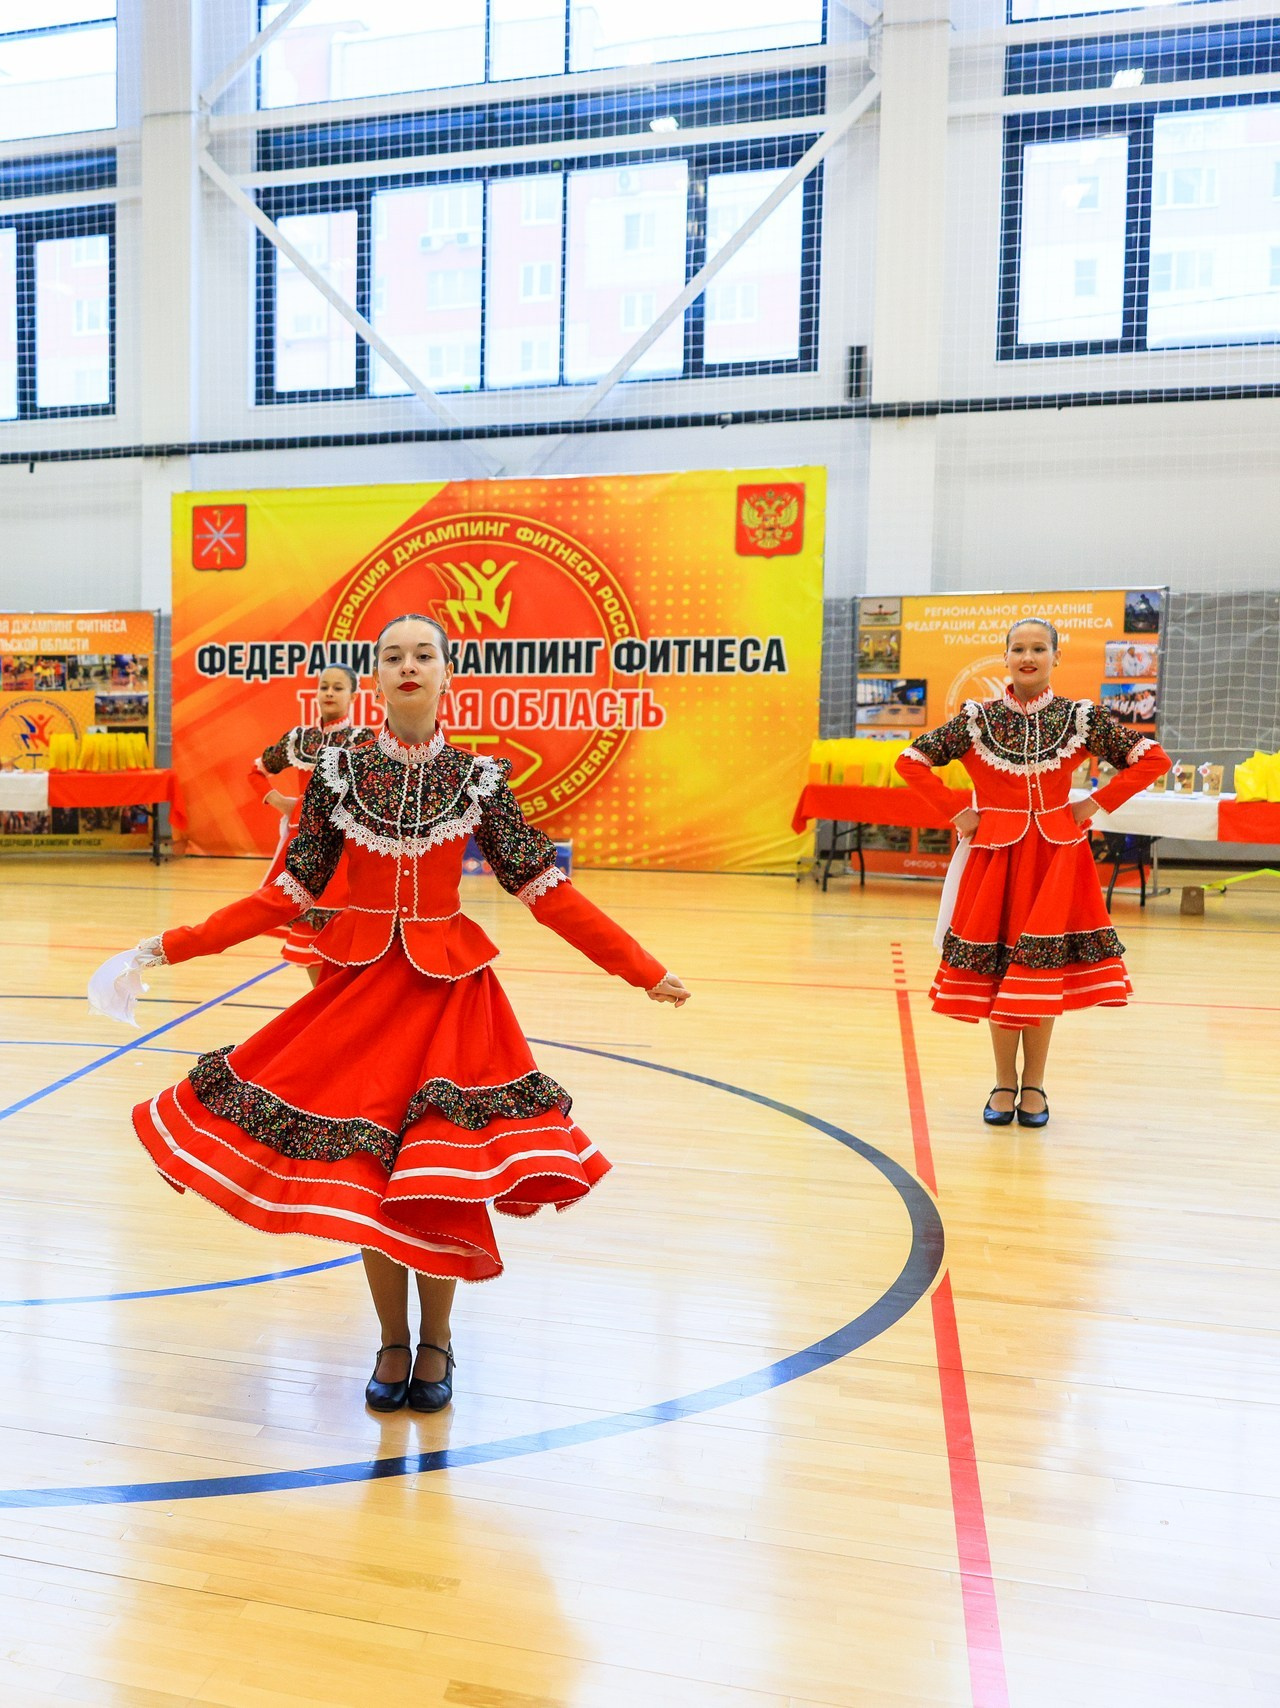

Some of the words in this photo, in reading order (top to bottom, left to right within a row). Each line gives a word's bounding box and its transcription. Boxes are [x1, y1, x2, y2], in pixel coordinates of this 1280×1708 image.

[332, 559, 391, 641] ДЕРАЦИЯ
[392, 521, 511, 565] ДЖАМПИНГ
[516, 527, 601, 588] ФИТНЕСА
[596, 585, 630, 640] РОСС
[924, 604, 1018, 617] РЕГИОНАЛЬНОЕ
[1021, 603, 1093, 616] ОТДЕЛЕНИЕ
[1054, 617, 1113, 629] ФИТНЕСА
[11, 619, 74, 634] ДЖАМПИНГ
[76, 619, 127, 633] ФИТНЕСА
[40, 637, 90, 652] ОБЛАСТИ
[196, 641, 375, 682] ФЕДЕРАЦИ
[613, 637, 787, 674] ФИТНЕСА
[491, 687, 665, 730] ОБЛАСТЬ
[549, 727, 620, 802] FEDERAT
